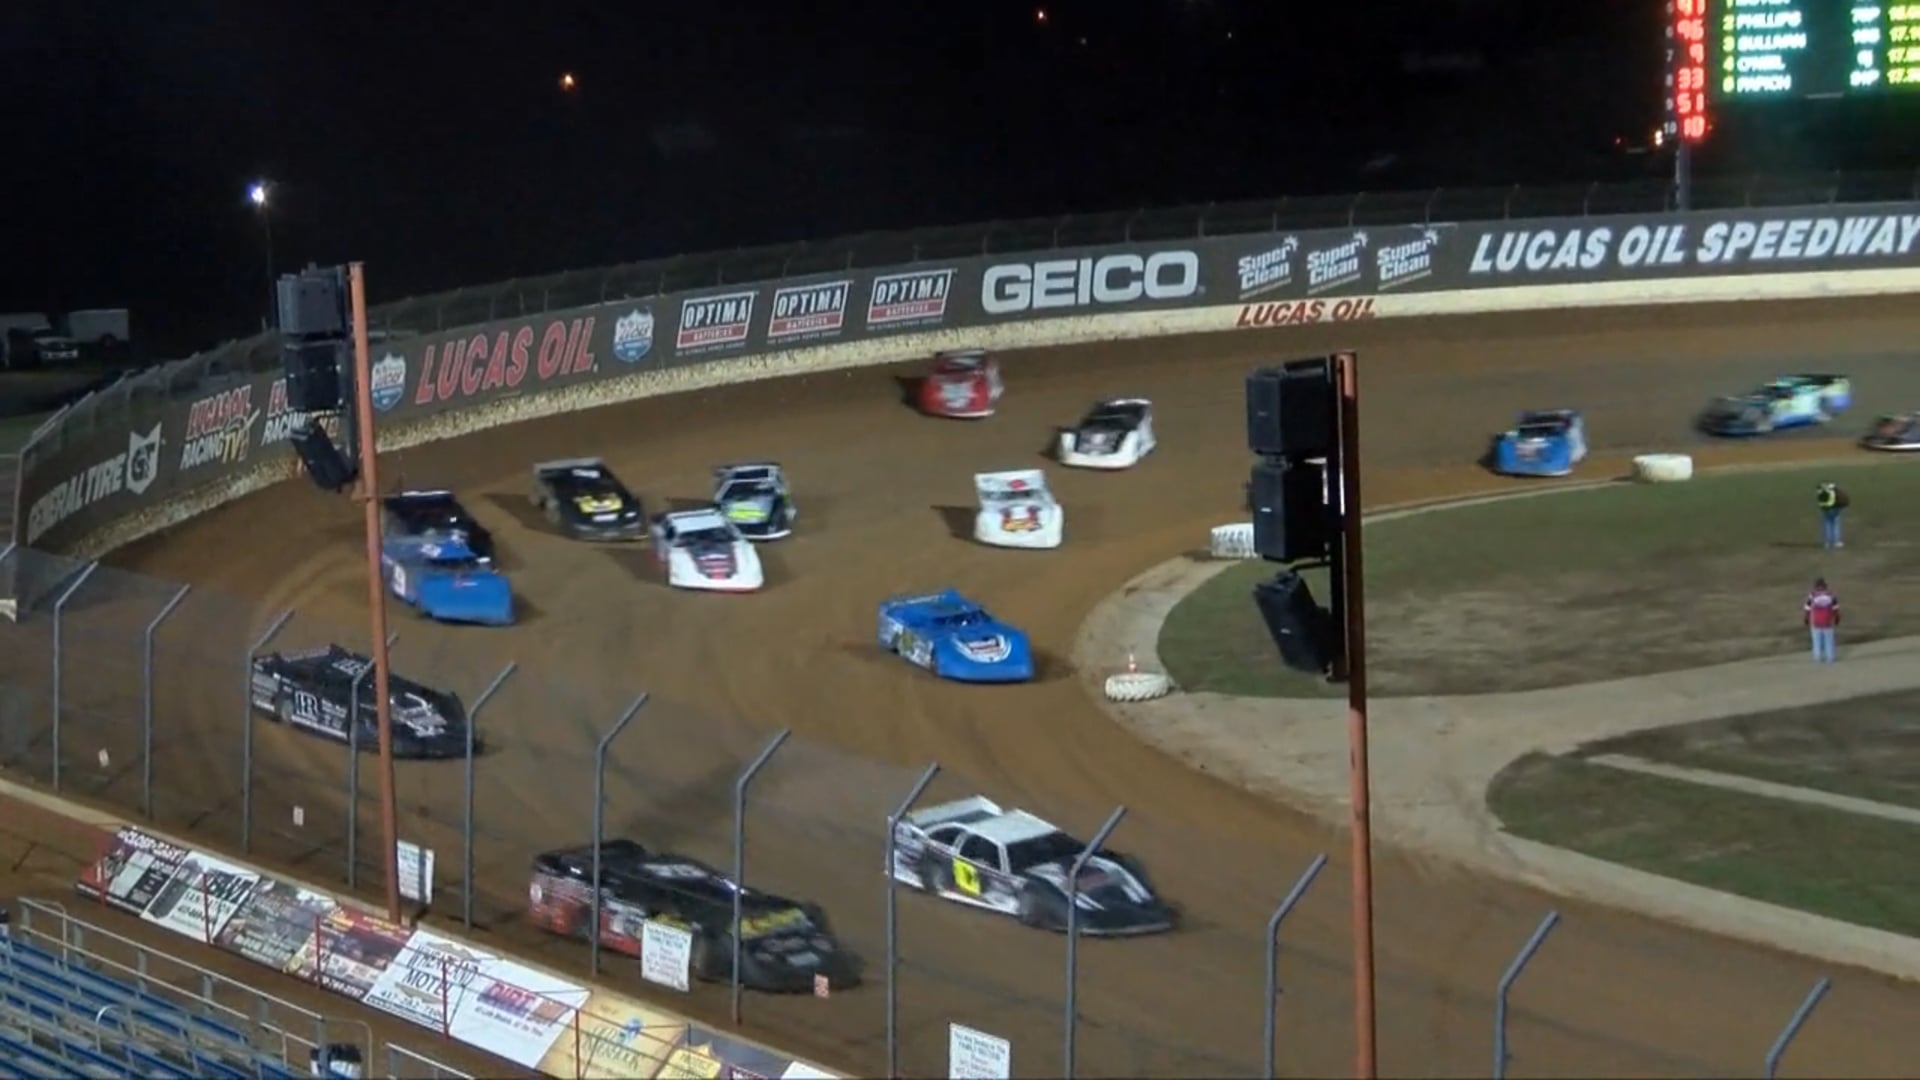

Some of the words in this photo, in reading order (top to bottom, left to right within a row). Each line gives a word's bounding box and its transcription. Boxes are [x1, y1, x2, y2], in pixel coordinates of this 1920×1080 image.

[1678, 68, 1704, 89] 33
[1677, 93, 1704, 113] 51
[1307, 241, 1361, 270] Super
[1377, 239, 1431, 266] Super
[1470, 228, 1612, 273] LUCAS
[1616, 225, 1686, 266] OIL
[1697, 214, 1920, 262] SPEEDWAY
[1238, 245, 1292, 275] Super
[1309, 257, 1359, 286] Clean
[1379, 254, 1431, 281] Clean
[876, 276, 945, 305] OPTIMA
[981, 250, 1200, 315] GEICO
[1241, 261, 1291, 291] Clean
[685, 299, 748, 329] OPTIMA
[777, 287, 842, 318] OPTIMA
[1236, 301, 1325, 327] LUCAS
[1331, 298, 1376, 321] OIL
[415, 325, 533, 405] LUCAS
[538, 317, 597, 380] OIL
[84, 452, 127, 505] TIRE
